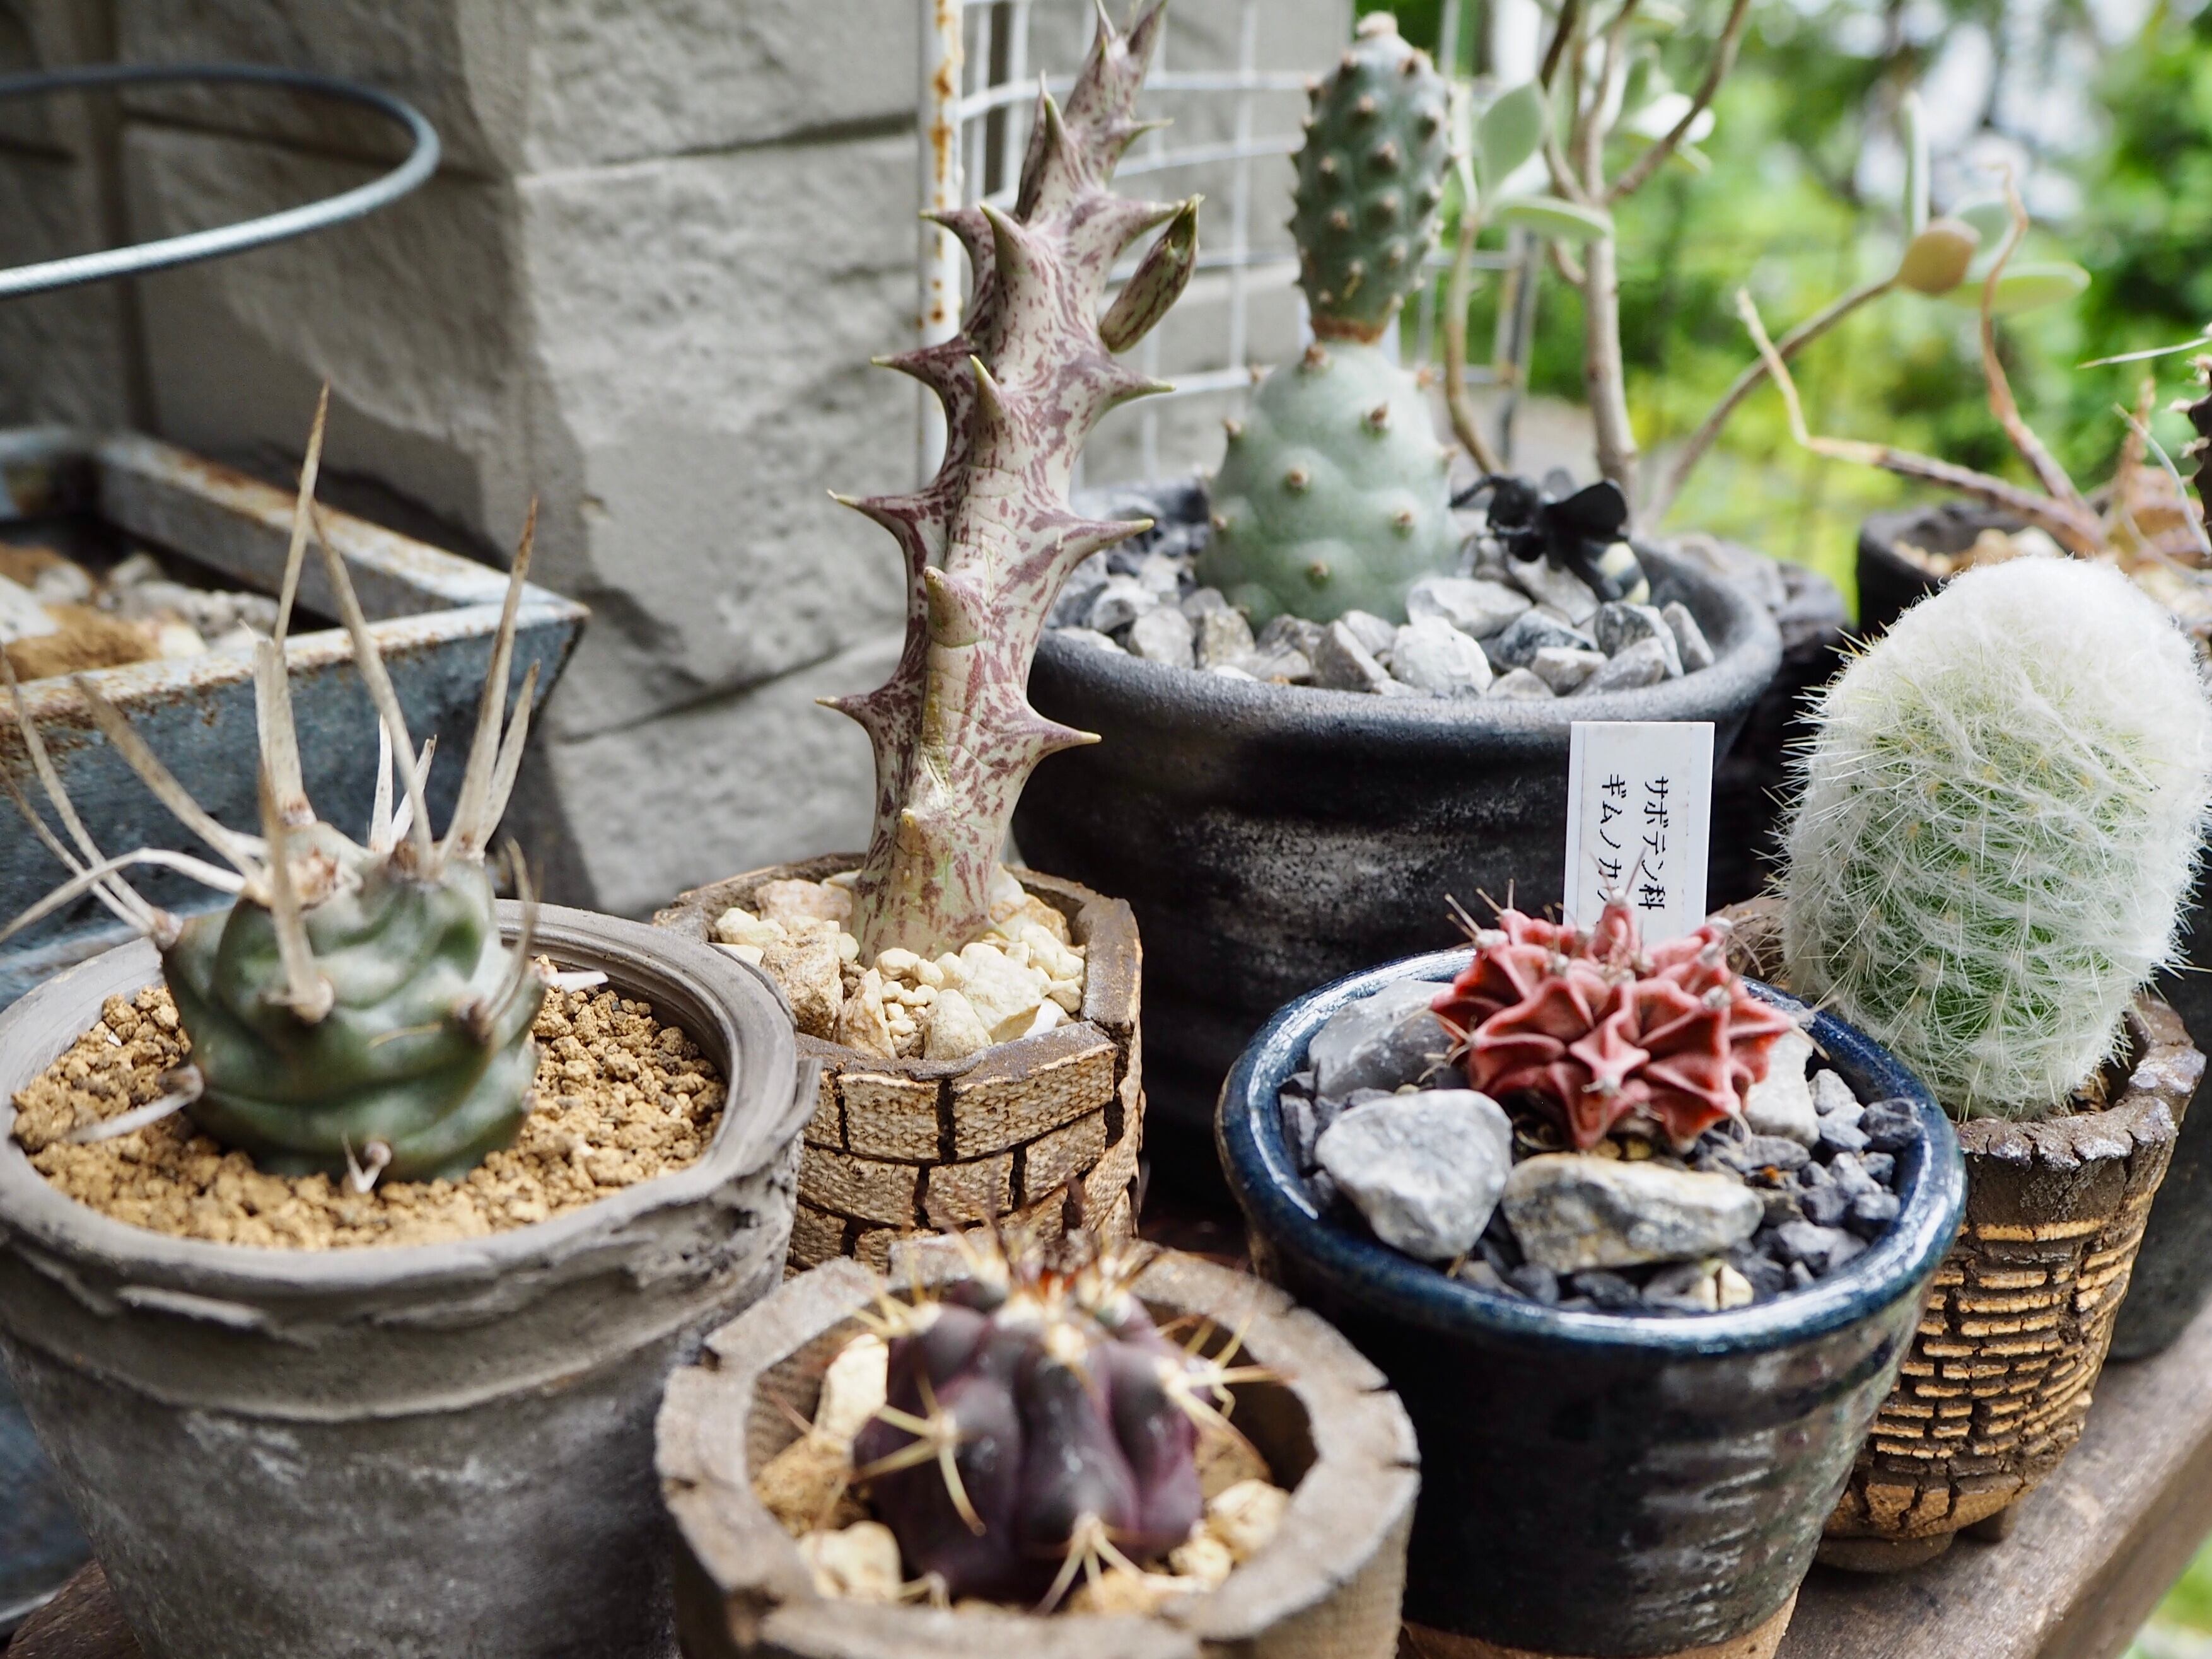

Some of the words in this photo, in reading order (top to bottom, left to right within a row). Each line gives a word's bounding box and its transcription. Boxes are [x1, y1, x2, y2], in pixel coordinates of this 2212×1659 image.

[1596, 773, 1627, 924] ギムノカ
[1638, 775, 1669, 911] サボテン科
